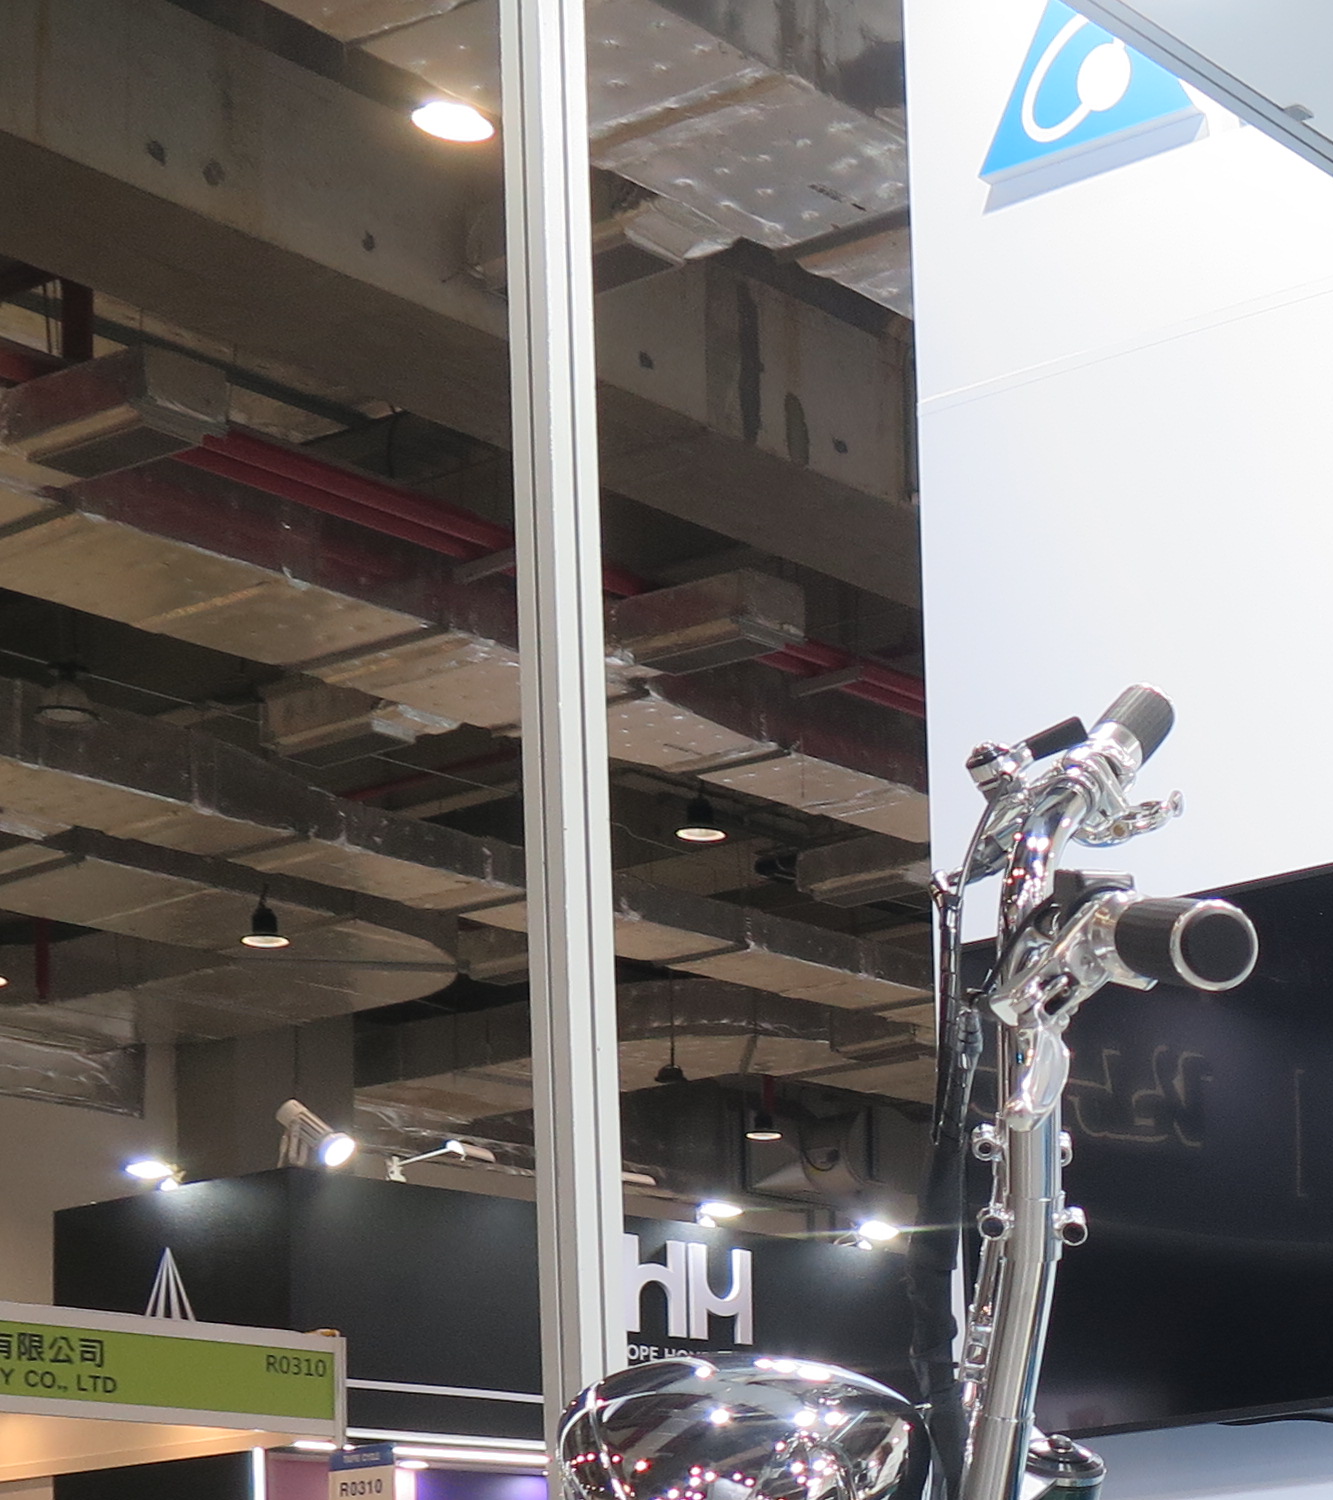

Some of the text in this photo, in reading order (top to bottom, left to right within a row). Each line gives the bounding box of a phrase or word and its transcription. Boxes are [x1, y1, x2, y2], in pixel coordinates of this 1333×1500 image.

[265, 1354, 327, 1379] R0310
[76, 1374, 117, 1394] LTD
[339, 1478, 383, 1498] R0310
